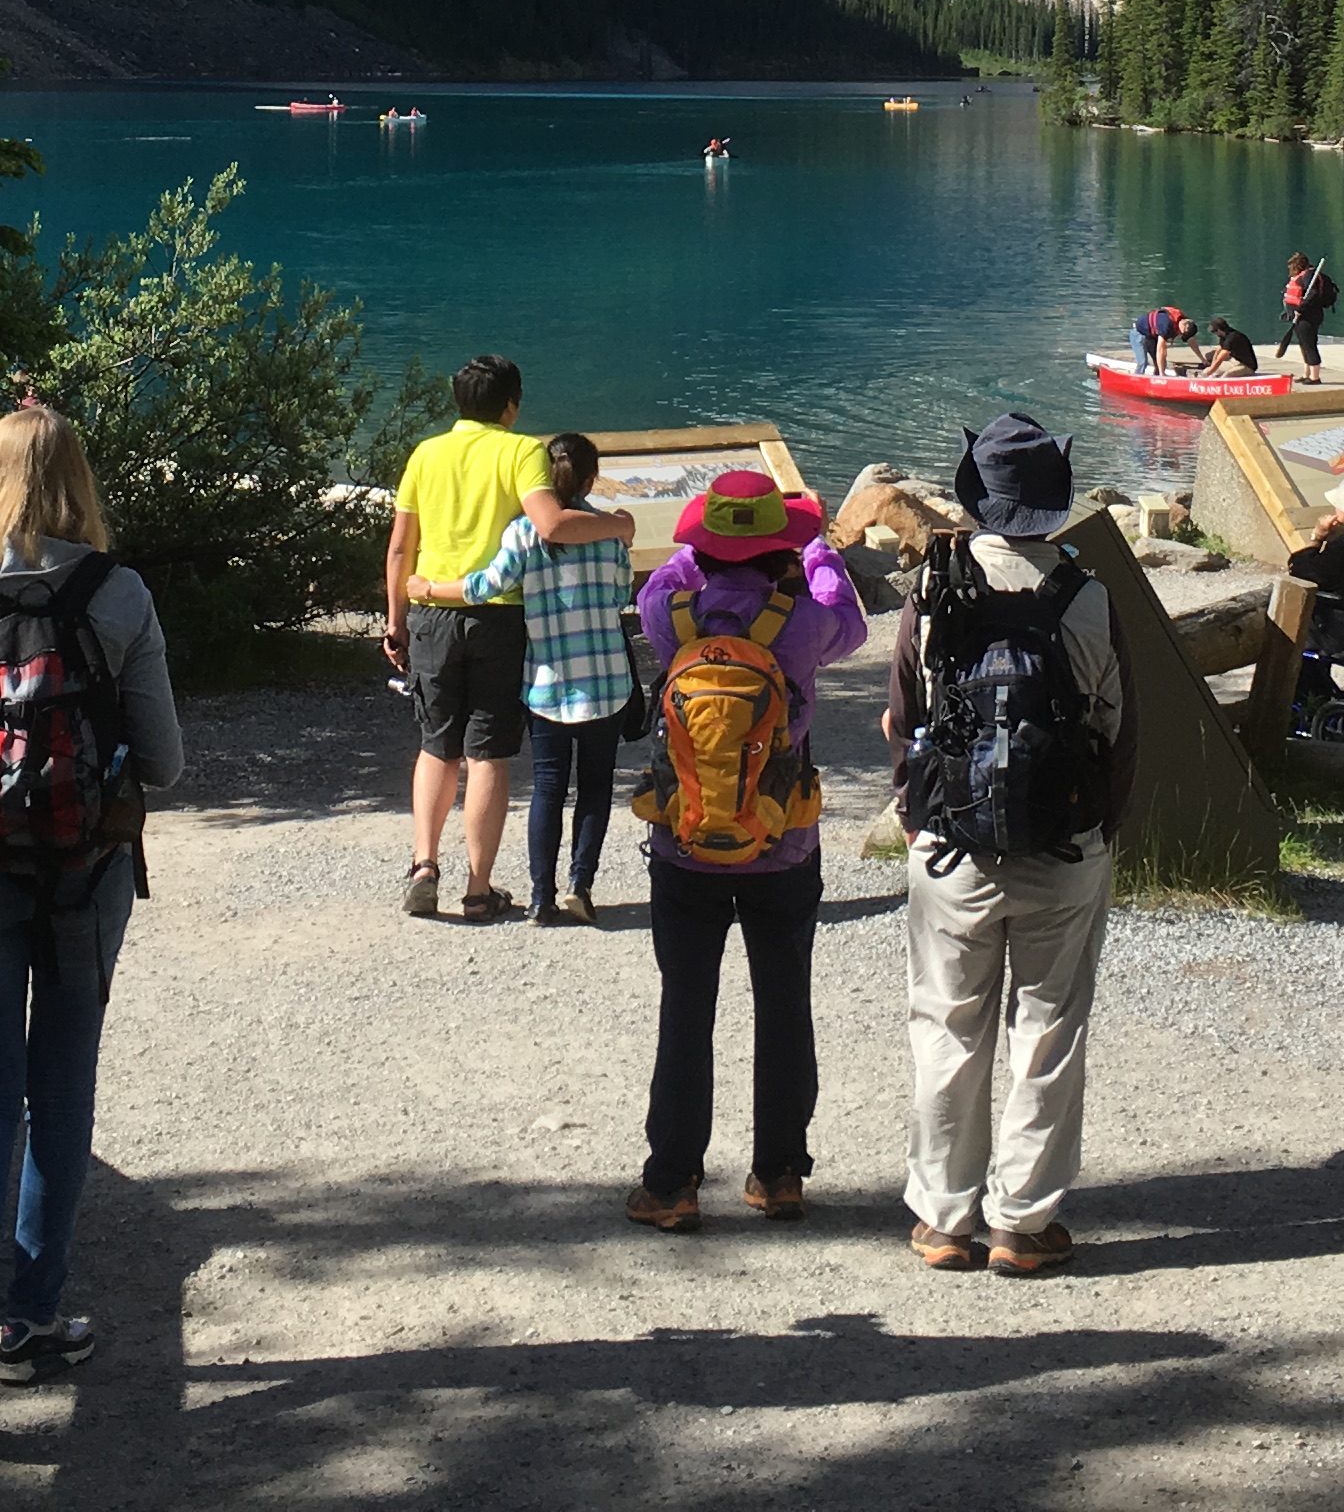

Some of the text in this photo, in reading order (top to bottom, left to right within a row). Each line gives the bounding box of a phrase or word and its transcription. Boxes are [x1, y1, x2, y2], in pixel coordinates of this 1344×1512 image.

[1189, 382, 1273, 395] MORAINE LAKE LODGE
